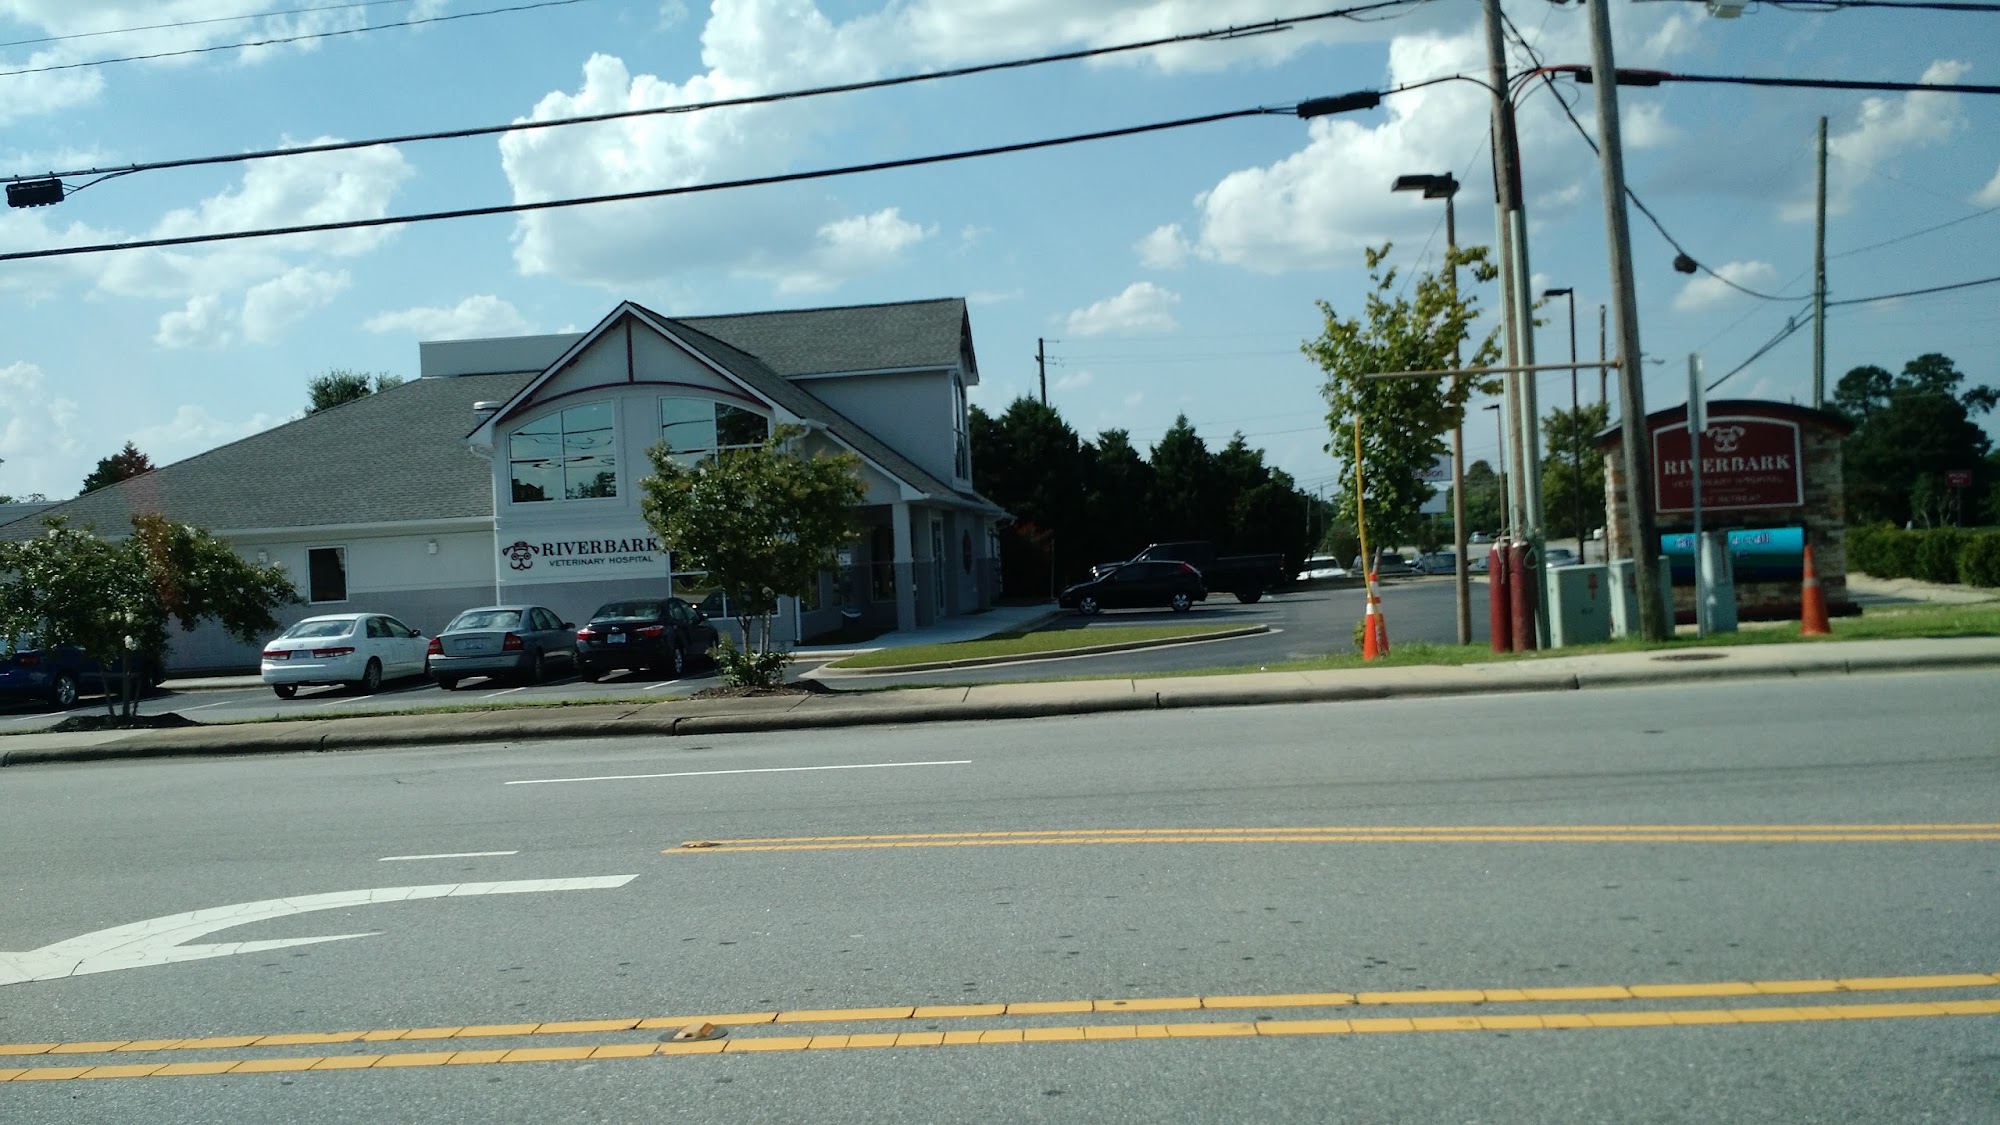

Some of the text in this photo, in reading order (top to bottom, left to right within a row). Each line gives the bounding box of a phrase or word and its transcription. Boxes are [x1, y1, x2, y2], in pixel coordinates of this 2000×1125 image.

[542, 538, 659, 556] RIVERBARK
[549, 555, 654, 567] VETERINARY HOSPITAL
